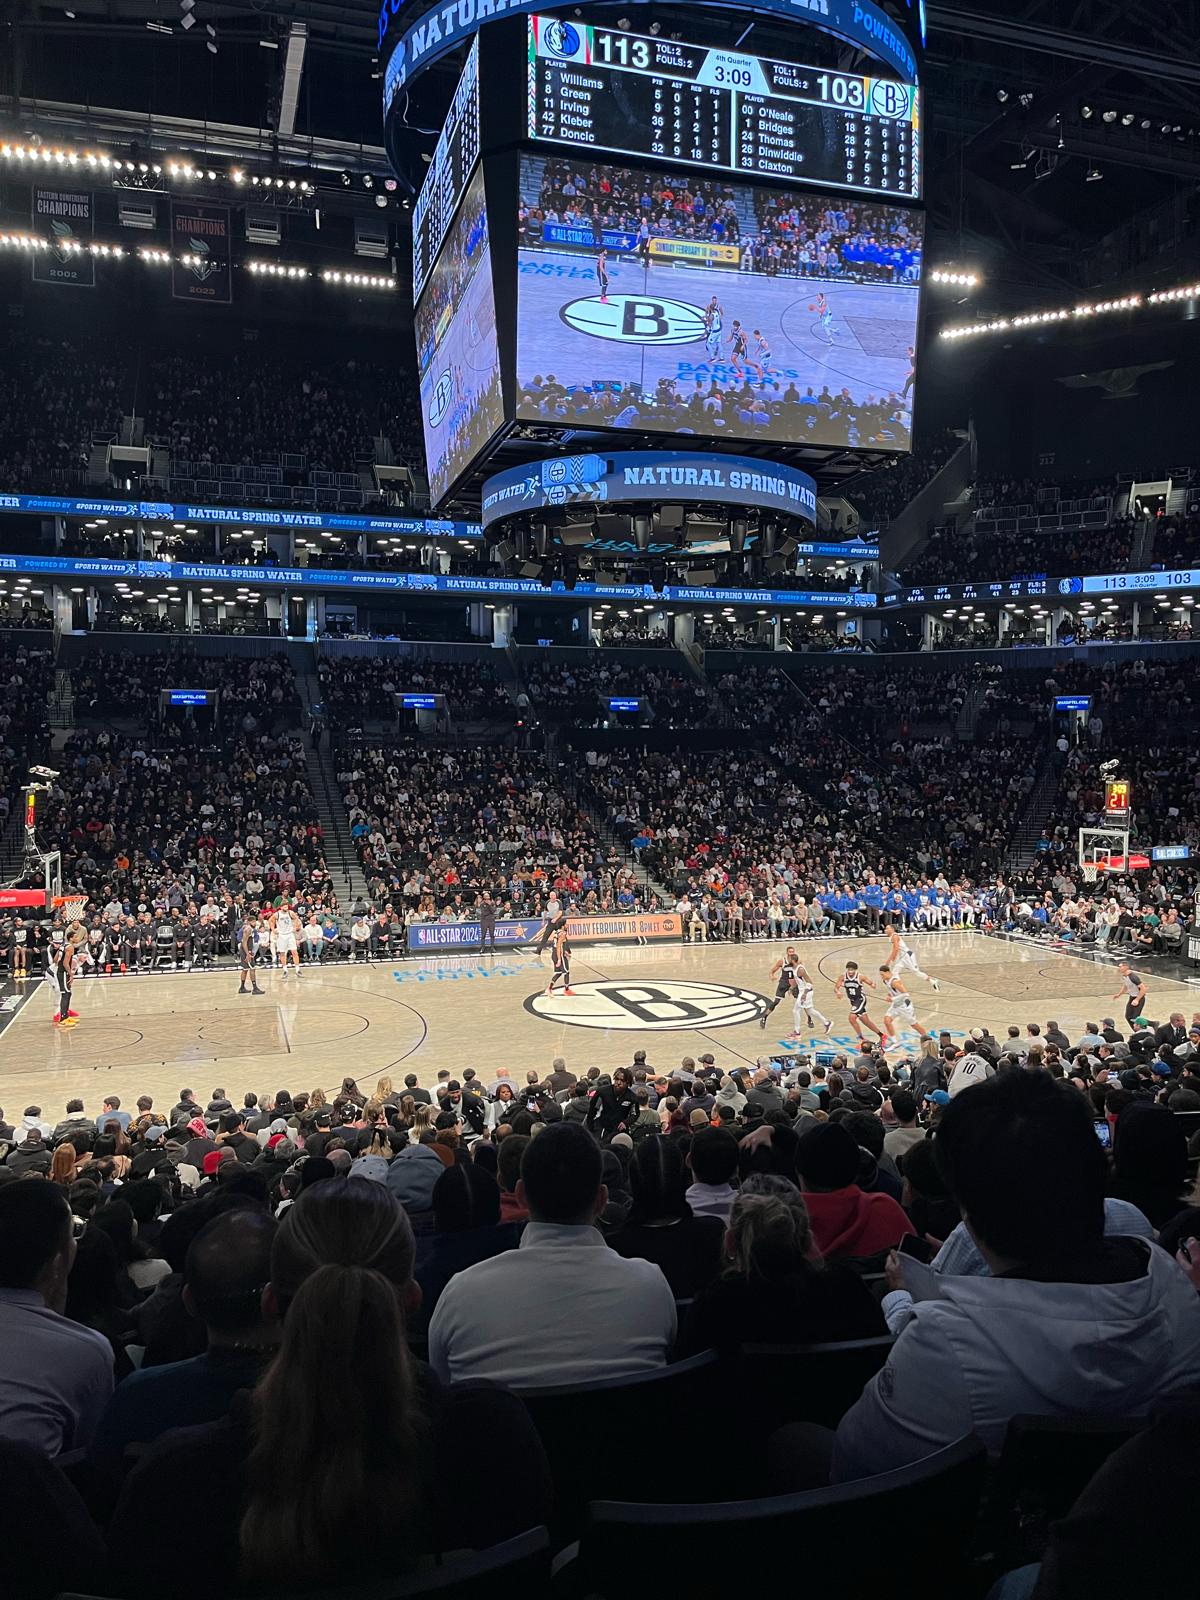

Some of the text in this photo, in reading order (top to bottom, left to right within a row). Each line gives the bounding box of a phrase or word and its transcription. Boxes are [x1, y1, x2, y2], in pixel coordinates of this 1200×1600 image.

[411, 0, 541, 61] NATUR
[854, 7, 906, 62] POWERED
[545, 60, 567, 69] PLAYER
[599, 35, 649, 69] 113
[727, 57, 751, 67] Quarter
[545, 71, 719, 109] 3 Williams 5 0 1 1
[715, 66, 751, 86] 3:09
[545, 84, 719, 123] 8 Green 9 3 1 1
[745, 95, 764, 103] PLAYER
[817, 76, 863, 106] 103
[542, 112, 719, 149] 42 Kleber 7 2 1 3
[543, 98, 719, 136] 11 Irving 36 4 2 1
[741, 106, 905, 141] 00 O'Neale 18 2 6 1
[542, 126, 719, 162] 77 Doncic 32 9 18 3
[741, 132, 905, 166] 24 Thomas 16 7 8 1
[745, 119, 905, 153] 1 Bridges 28 4 1 0
[741, 145, 905, 178] 26 Dinwiddie 5 5 1 0
[741, 158, 905, 191] 33 Claxton 9 2 9 2
[37, 200, 89, 217] CHAMPIONS
[176, 219, 226, 236] CHAMPIONS
[49, 269, 78, 278] 2002
[621, 301, 669, 337] B
[499, 483, 525, 501] WATER
[624, 467, 725, 487] NATURAL
[729, 471, 786, 496] SPRING
[76, 503, 102, 511] SPORTS
[188, 508, 240, 520] NATURAL
[242, 511, 280, 523] SPRING
[282, 514, 322, 525] WATER
[183, 567, 229, 577] NATURAL
[231, 569, 264, 579] SPRING
[267, 571, 302, 580] WATER
[447, 580, 487, 589] NATURAL
[489, 582, 518, 591] SPRING
[678, 590, 715, 599] NATURAL
[716, 591, 743, 600] SPRING
[744, 593, 772, 601] WATER
[1104, 577, 1127, 589] 113
[1135, 575, 1155, 583] 3:09
[1167, 573, 1191, 585] 103
[1110, 793, 1125, 808] 21
[461, 926, 479, 942] 2024
[493, 928, 509, 937] NDY
[566, 922, 591, 937] UNDAY
[592, 921, 627, 935] FEBRUARY
[629, 920, 637, 933] 18
[597, 986, 708, 1023] B
[963, 1062, 976, 1075] 10
